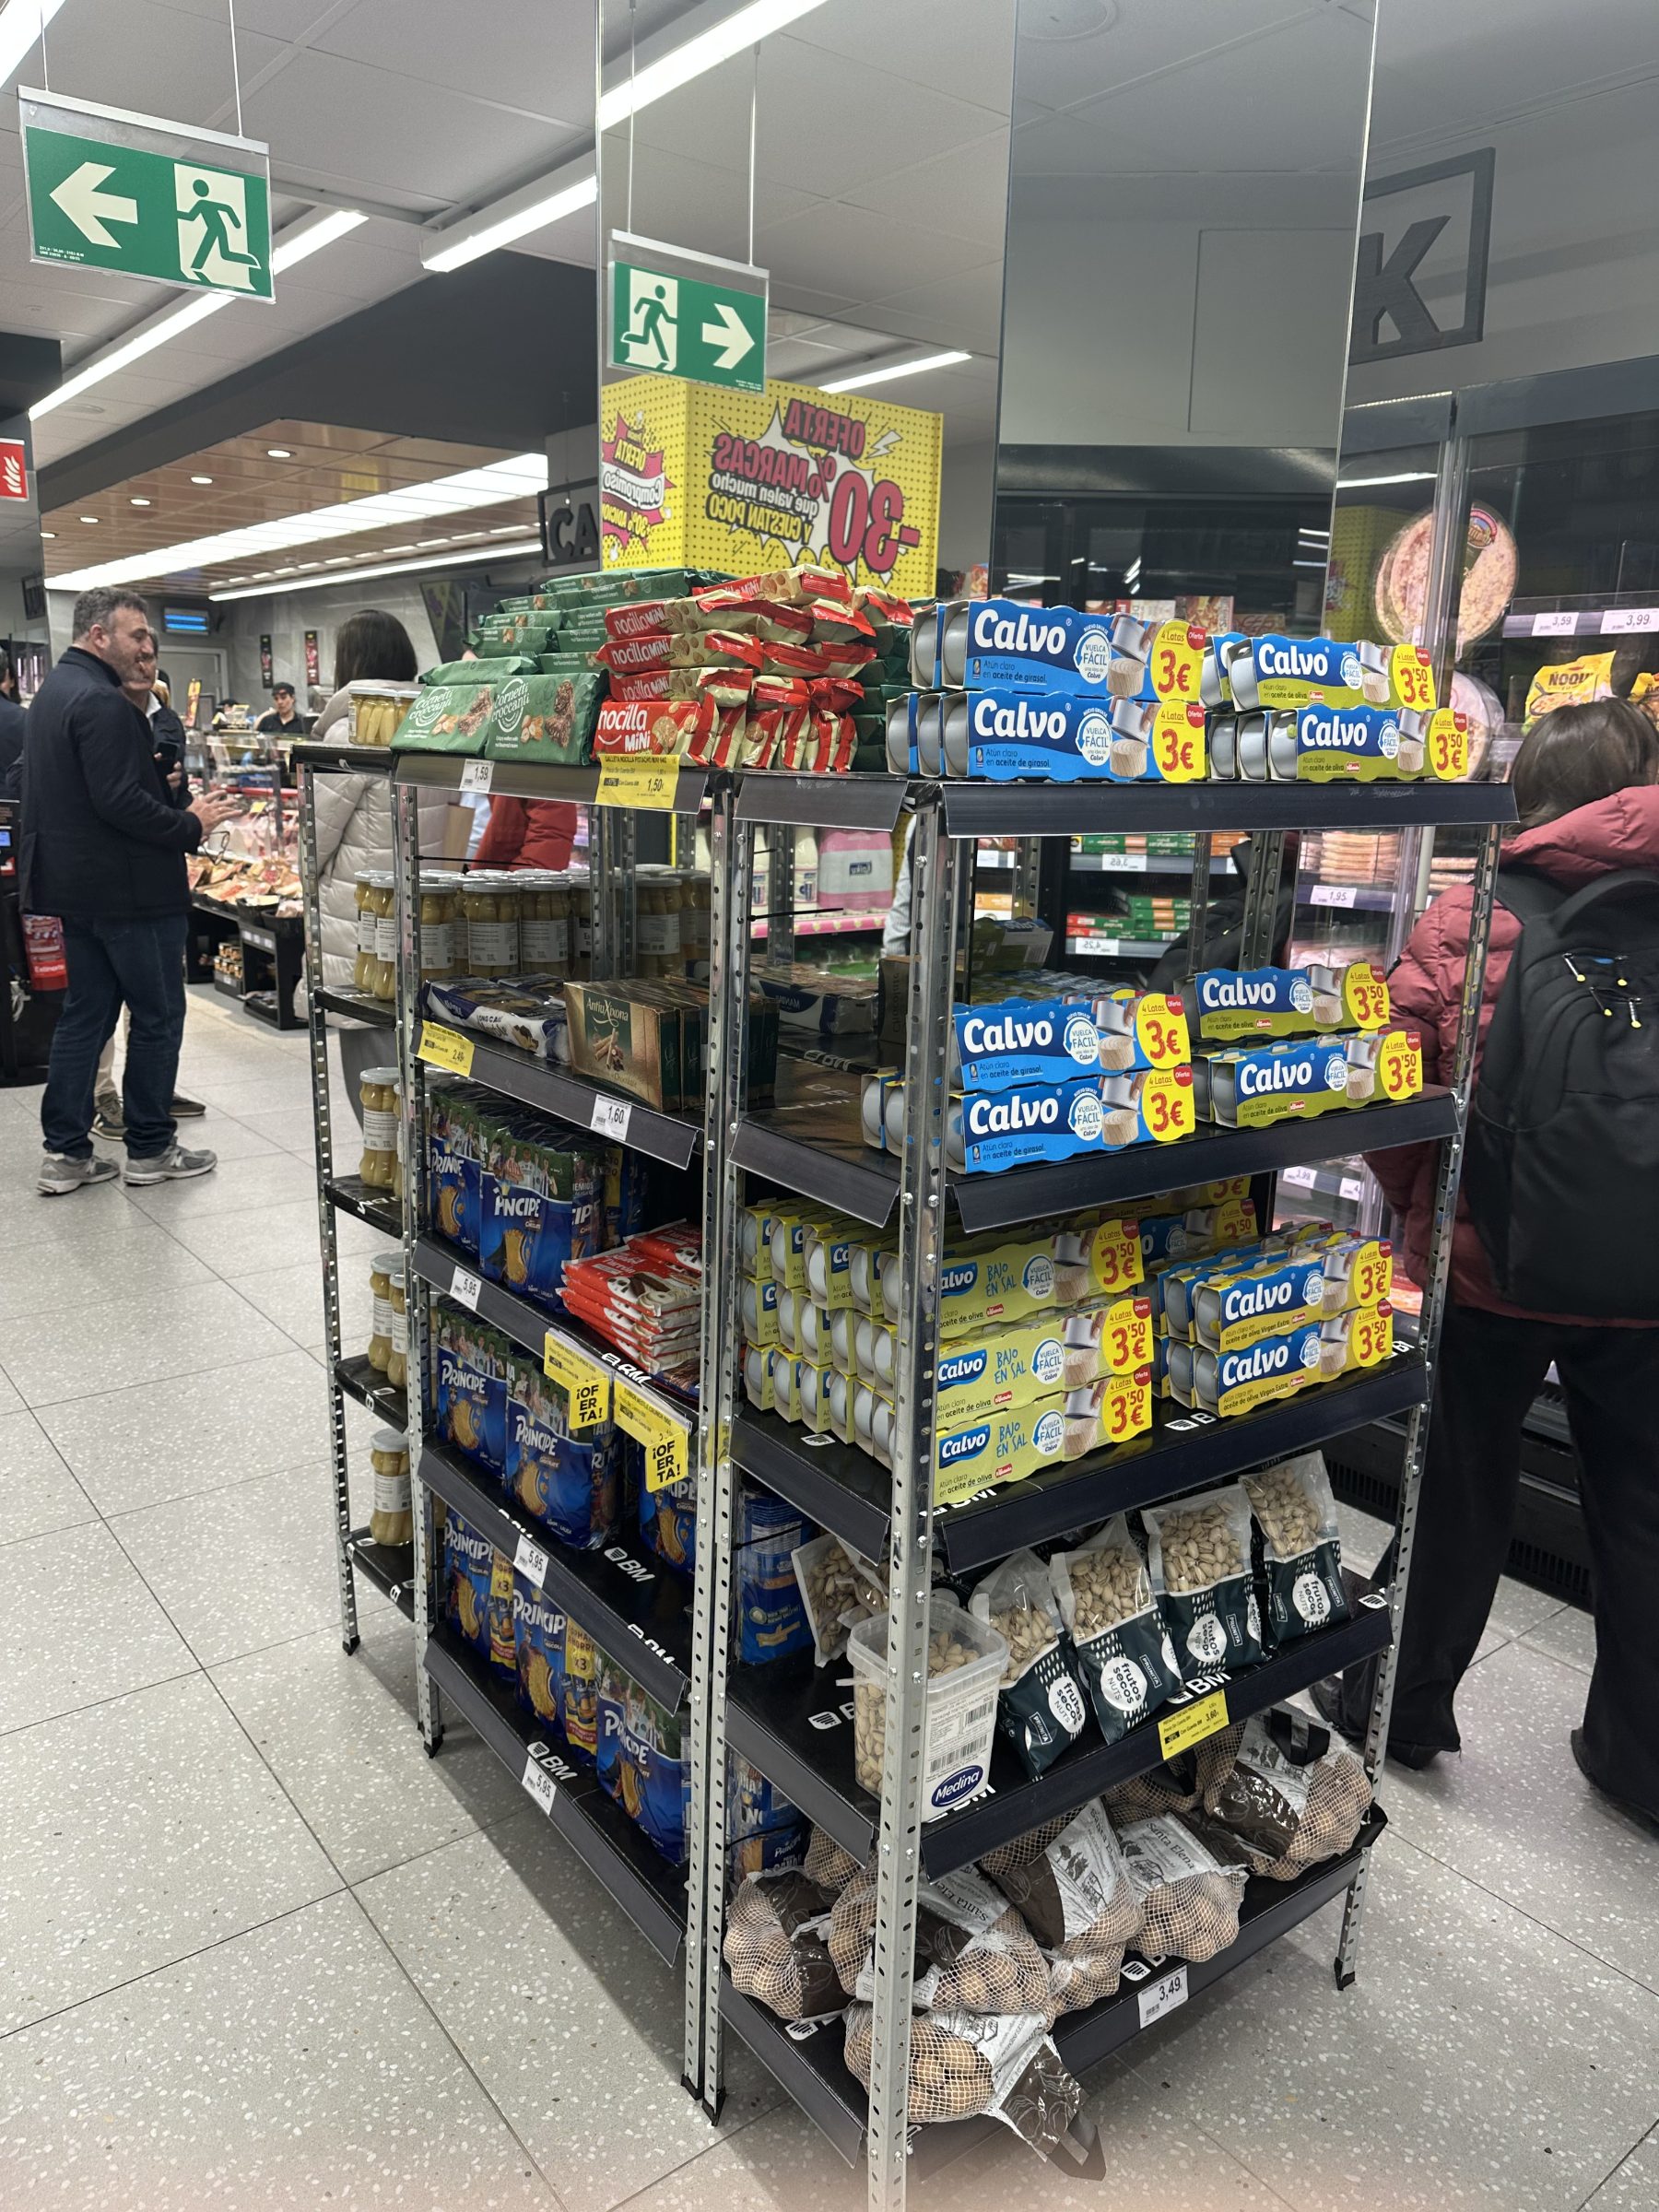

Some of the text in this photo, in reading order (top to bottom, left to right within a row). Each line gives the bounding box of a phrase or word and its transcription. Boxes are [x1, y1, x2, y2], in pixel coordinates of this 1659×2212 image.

[615, 611, 646, 634] nocilla
[974, 609, 1066, 654] Calvo
[1167, 632, 1184, 641] Latas
[1187, 631, 1204, 641] Oferta
[612, 641, 649, 664] nocilla
[1084, 653, 1107, 666] FÁCIL
[1086, 644, 1106, 653] VUELCA
[1258, 643, 1328, 676] Calvo
[993, 672, 1013, 680] aceite
[1159, 650, 1190, 693] 3€
[416, 688, 453, 711] Cornetti
[623, 679, 652, 700] nocilla
[409, 698, 453, 720] croccanti
[598, 703, 647, 731] nocilla
[974, 698, 1066, 739] Calvo
[1167, 712, 1184, 721] Latas
[1086, 735, 1109, 748] FÁCIL
[1087, 726, 1107, 735] VUELCA
[1301, 714, 1368, 747] Calvo
[1161, 728, 1194, 771] 3€
[995, 758, 1017, 767] aceite
[1203, 978, 1276, 1007] Calvo
[1147, 1004, 1165, 1012] Latas
[963, 1017, 1053, 1053] Calvo
[1072, 1038, 1096, 1049] FÁCIL
[1146, 1020, 1182, 1060] 3€
[990, 1069, 1009, 1077] aceite
[1154, 1076, 1172, 1084] Latas
[1240, 1061, 1312, 1095] Calvo
[969, 1095, 1059, 1135] Calvo
[1077, 1112, 1100, 1124] FÁCIL
[1078, 1104, 1098, 1112] VUELCA
[1150, 1091, 1184, 1133] 3€
[992, 1150, 1012, 1159] aceite
[1103, 1230, 1122, 1239] Latas
[986, 1264, 1008, 1282] BAJO
[1030, 1264, 1050, 1274] VUELCA
[1030, 1272, 1053, 1286] FÁCIL
[986, 1276, 1017, 1298] EN SAL
[1224, 1281, 1291, 1321] Calvo
[1114, 1310, 1132, 1320] Latas
[996, 1348, 1018, 1369] BAJO
[1040, 1348, 1059, 1359] VUELCA
[1040, 1357, 1062, 1371] FÁCIL
[1222, 1344, 1288, 1386] Calvo
[937, 1359, 983, 1382] Calvo
[994, 1361, 1027, 1385] EN SAL
[1114, 1378, 1132, 1388] Latas
[946, 1400, 991, 1418] aceite oliva
[999, 1422, 1020, 1439] BAJO
[1040, 1428, 1063, 1441] FÁCIL
[1041, 1419, 1061, 1430] VUELCA
[942, 1432, 986, 1458] Calvo
[996, 1434, 1028, 1459] EN SAL
[947, 1483, 966, 1494] aceite
[618, 1559, 655, 1583] BM
[1302, 1583, 1316, 1616] secos
[1311, 1580, 1324, 1616] frutos
[1207, 1619, 1220, 1656] frutos
[1230, 1617, 1241, 1644] PRUNITA
[1122, 1663, 1142, 1701] frutos
[1143, 1658, 1159, 1687] PRUNITA
[1185, 1672, 1231, 1694] BM
[1108, 1677, 1122, 1700] NUTS
[1113, 1666, 1134, 1704] secos
[1054, 1700, 1070, 1724] NUTS
[1057, 1689, 1078, 1725] secos
[1064, 1682, 1083, 1721] frutos
[1034, 1715, 1049, 1742] PRUNITA
[541, 1755, 578, 1782] BM
[935, 1771, 980, 1803] Medina
[1146, 1822, 1195, 1870] Santa Elena
[957, 1896, 989, 1922] Santa
